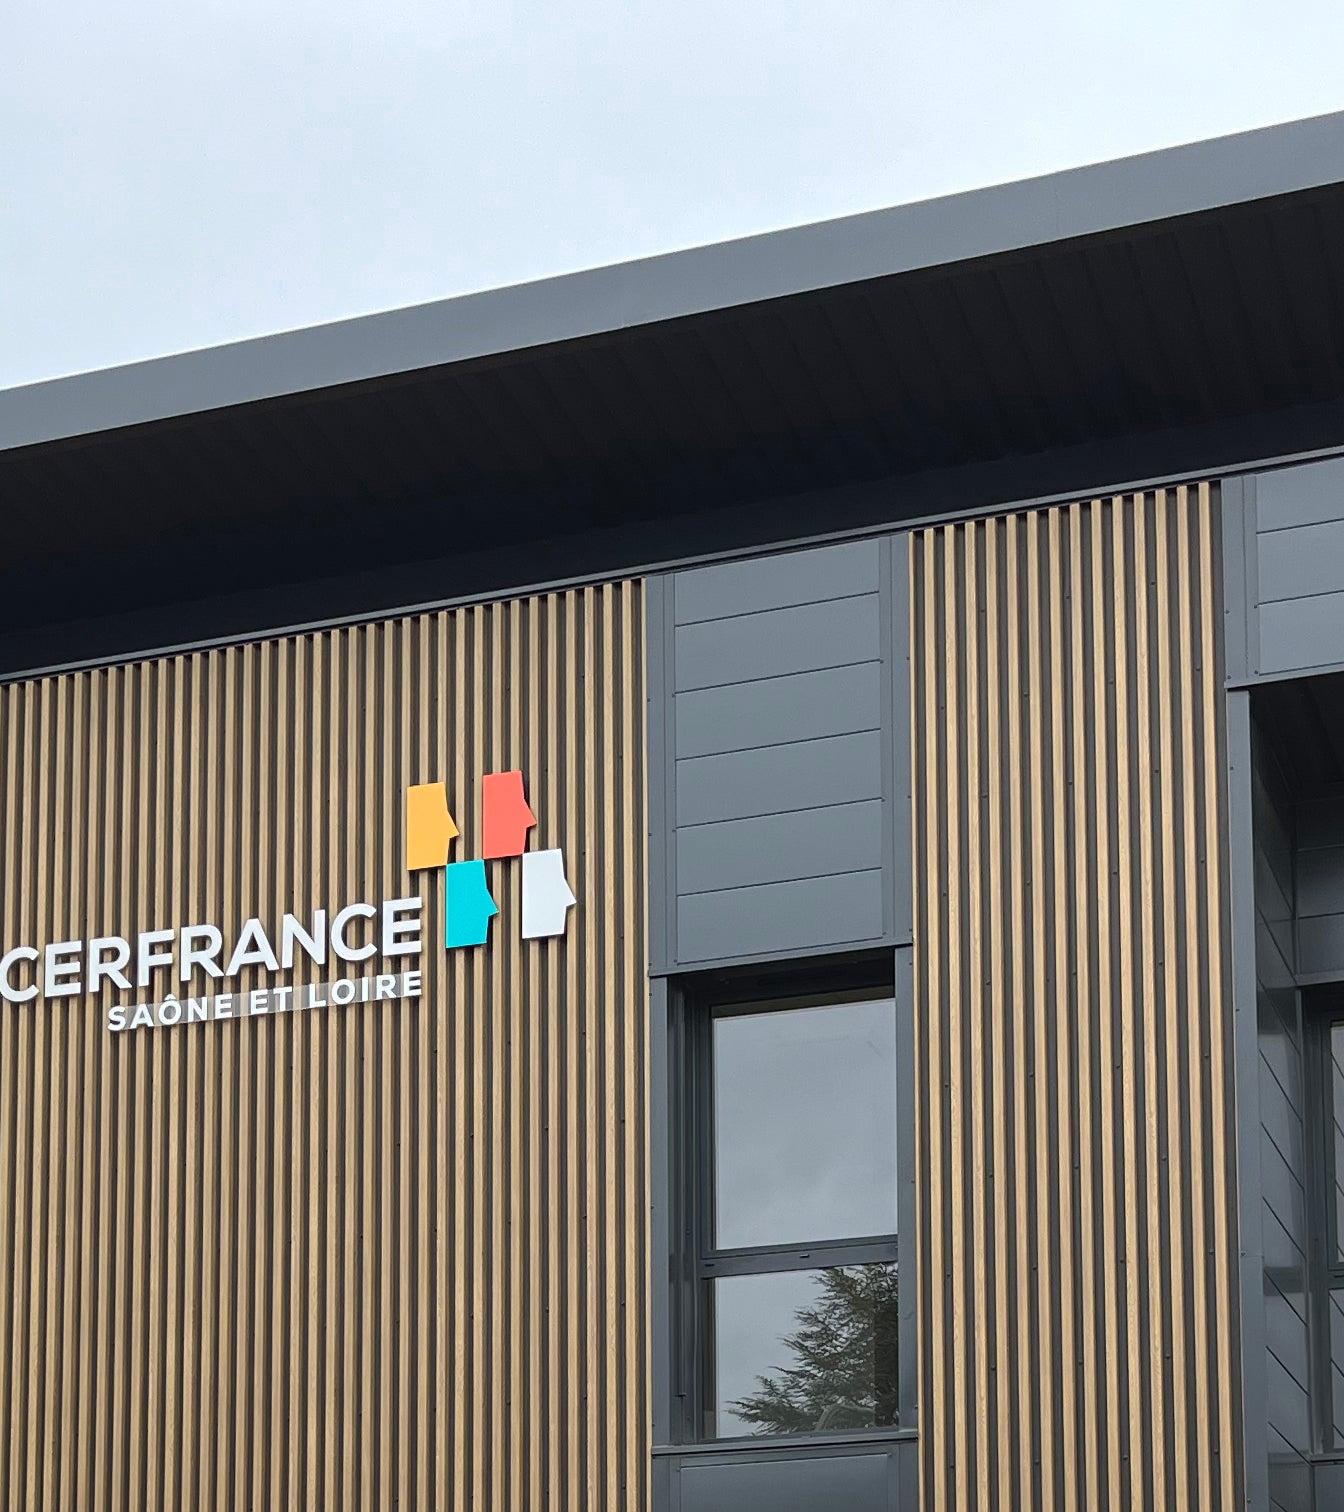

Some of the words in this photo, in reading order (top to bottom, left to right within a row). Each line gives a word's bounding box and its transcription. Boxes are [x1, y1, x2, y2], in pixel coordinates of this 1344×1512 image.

[108, 993, 233, 1032] SAÔNE
[250, 986, 292, 1015] ET
[309, 970, 422, 1009] LOIRE
